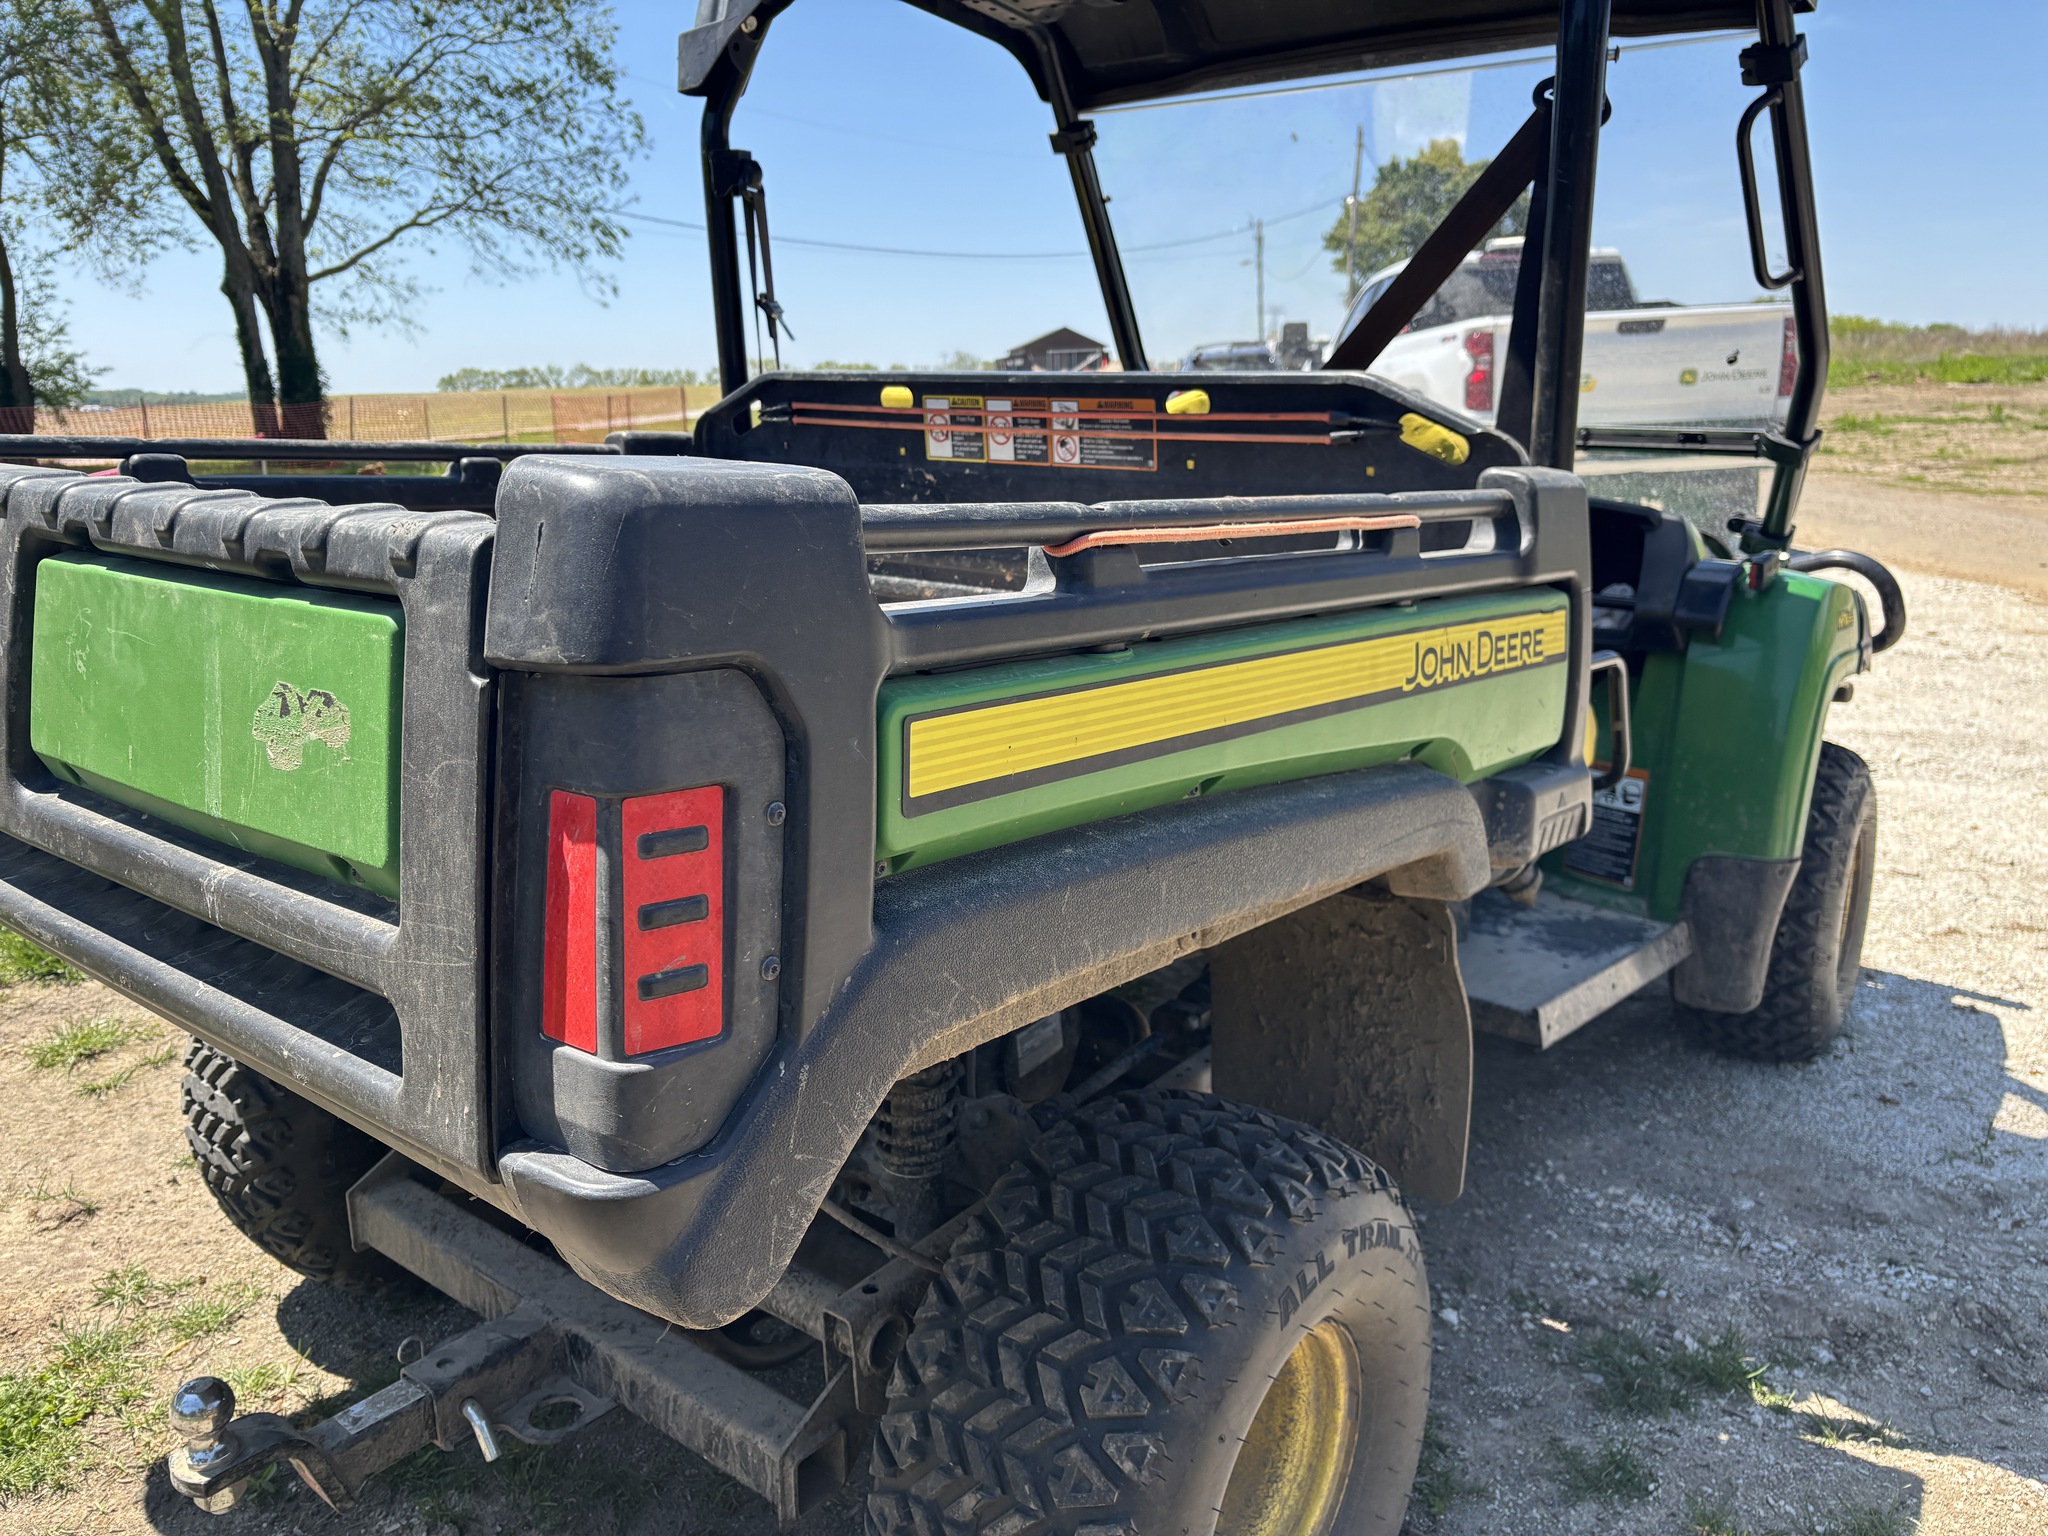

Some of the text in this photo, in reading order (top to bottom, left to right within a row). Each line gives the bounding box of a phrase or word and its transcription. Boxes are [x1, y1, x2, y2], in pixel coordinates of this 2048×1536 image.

[1701, 367, 1768, 382] JOHN DEERE
[957, 398, 980, 406] CAUTION
[1018, 399, 1046, 408] WARNING
[1104, 400, 1134, 409] WARNING
[1403, 628, 1545, 689] JOHN DEERE
[1278, 1250, 1335, 1331] ALL
[1342, 1222, 1404, 1259] TRAIL
